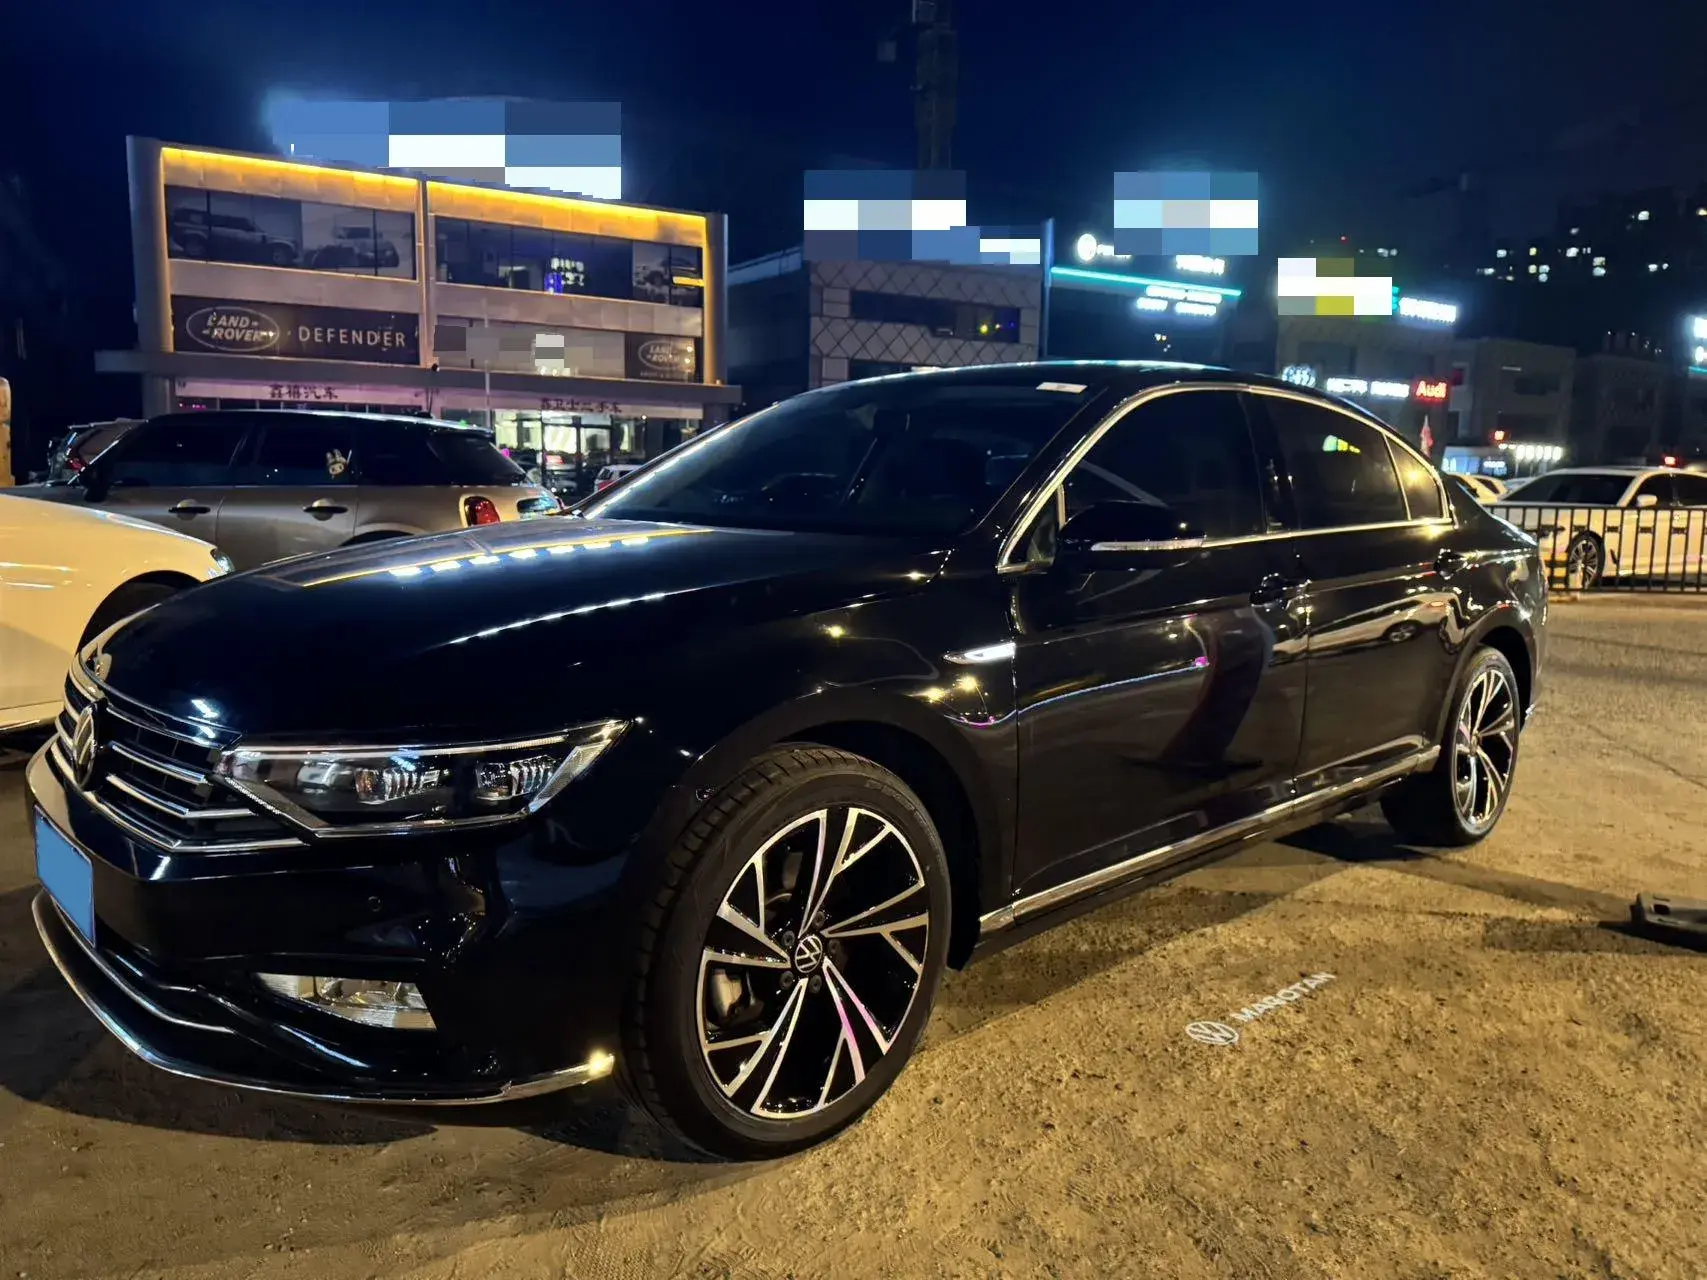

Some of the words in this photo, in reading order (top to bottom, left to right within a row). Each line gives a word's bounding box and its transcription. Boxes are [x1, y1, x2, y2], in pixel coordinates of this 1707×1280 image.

[206, 314, 251, 328] LAND
[211, 328, 263, 342] ROVER
[298, 326, 406, 348] DEFENDER
[1415, 380, 1448, 399] Audi
